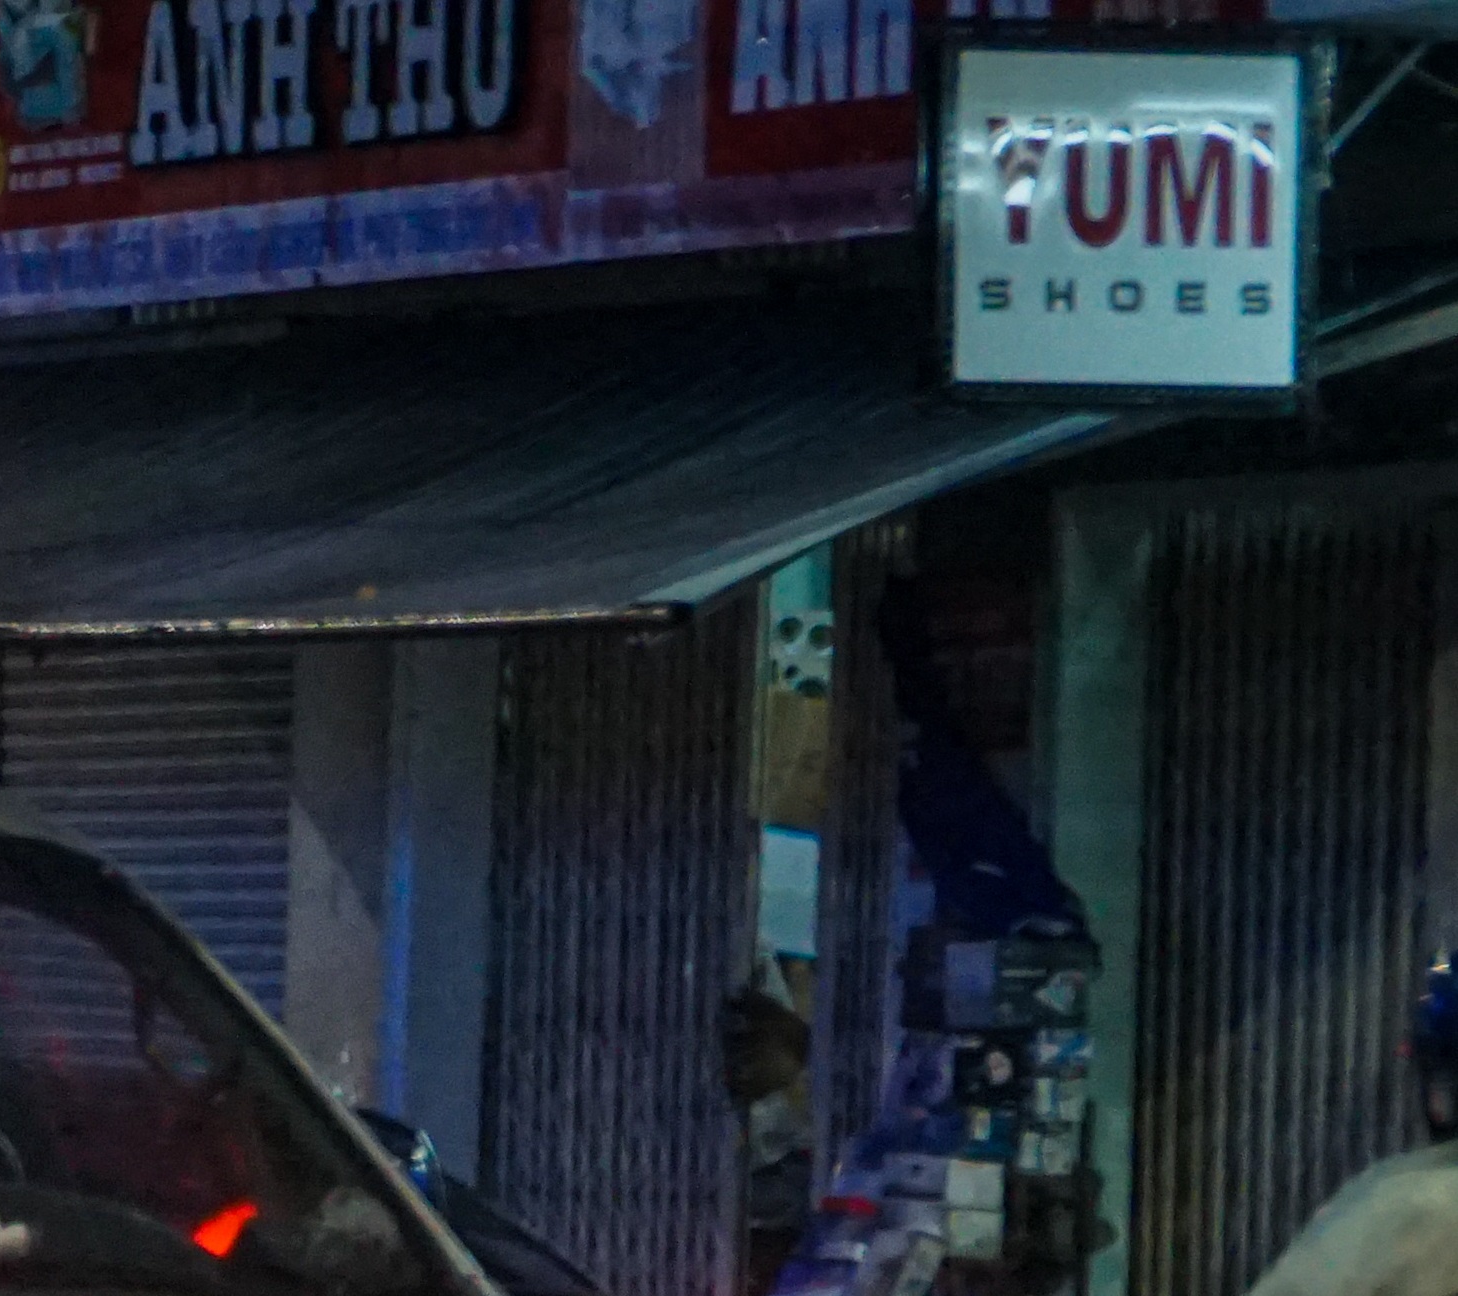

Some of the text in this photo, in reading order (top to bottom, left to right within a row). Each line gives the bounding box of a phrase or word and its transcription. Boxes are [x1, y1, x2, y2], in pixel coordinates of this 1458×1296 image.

[131, 0, 315, 166] ANH
[985, 116, 1274, 248] YUMI
[978, 278, 1274, 316] SHOES
